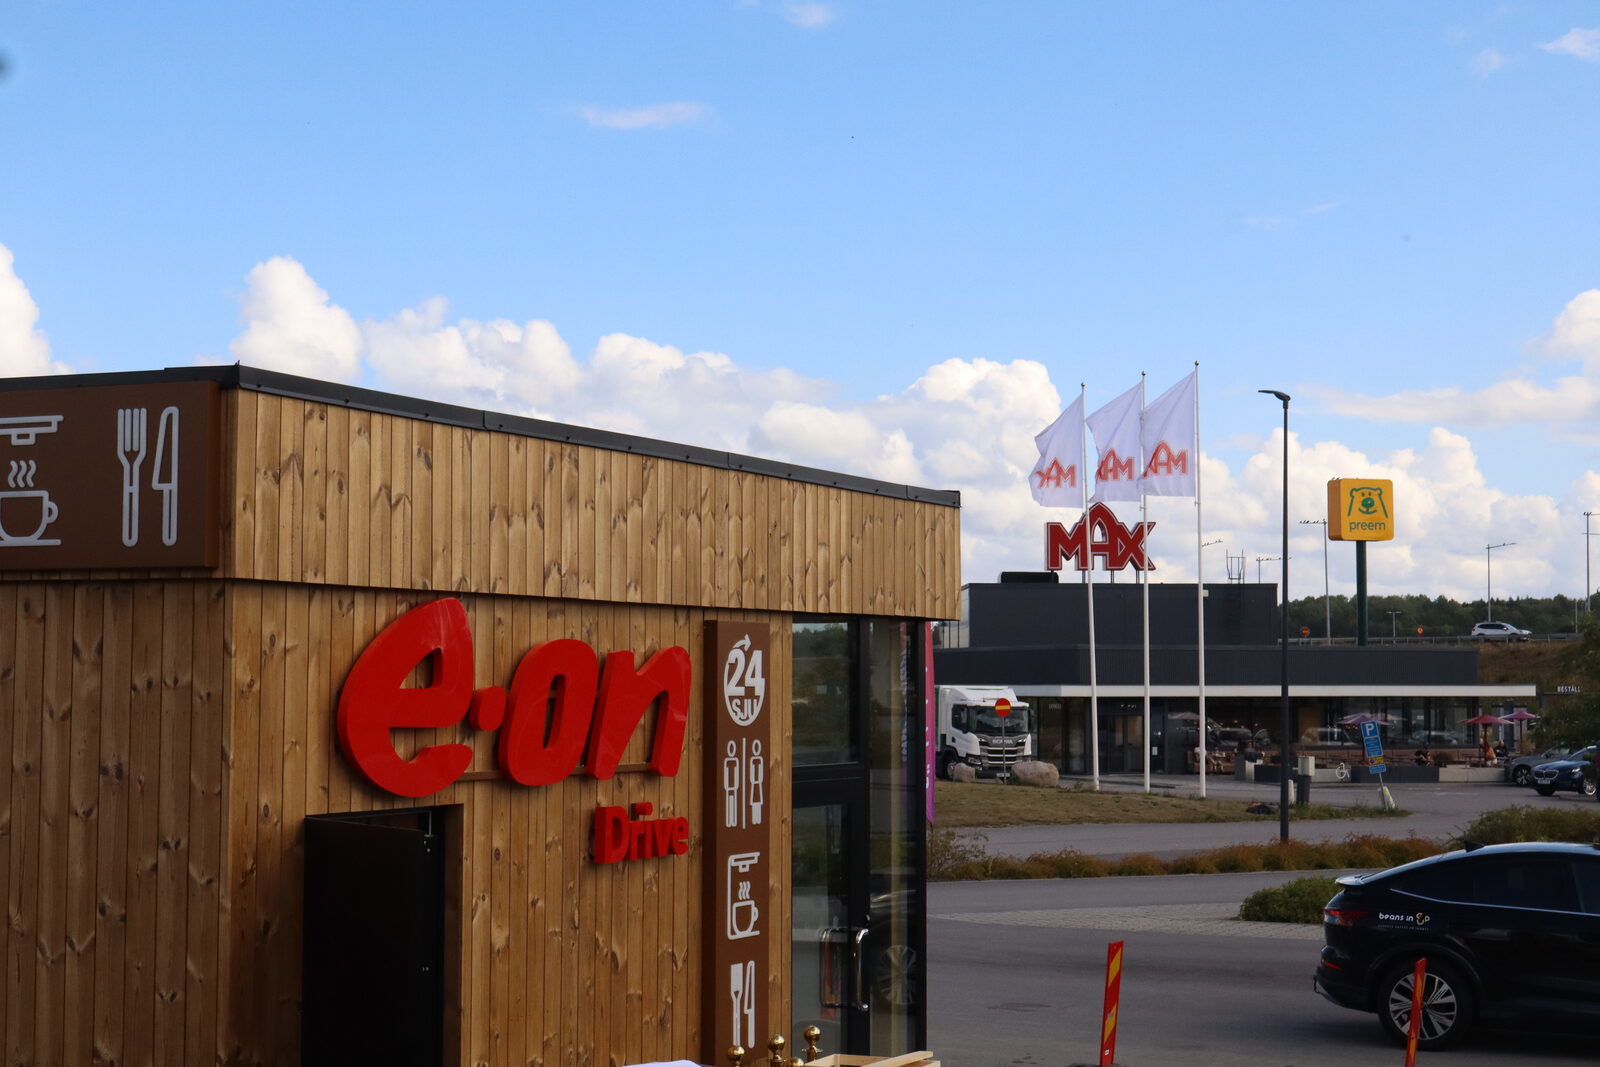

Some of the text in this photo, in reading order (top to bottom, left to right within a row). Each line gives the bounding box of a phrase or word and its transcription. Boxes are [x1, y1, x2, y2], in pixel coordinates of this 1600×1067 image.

[1044, 502, 1156, 570] MAX
[1349, 521, 1386, 533] preem
[727, 648, 765, 696] 24
[732, 699, 759, 720] SJU
[1365, 723, 1375, 736] P
[593, 802, 689, 864] Drive
[1379, 912, 1404, 921] beans
